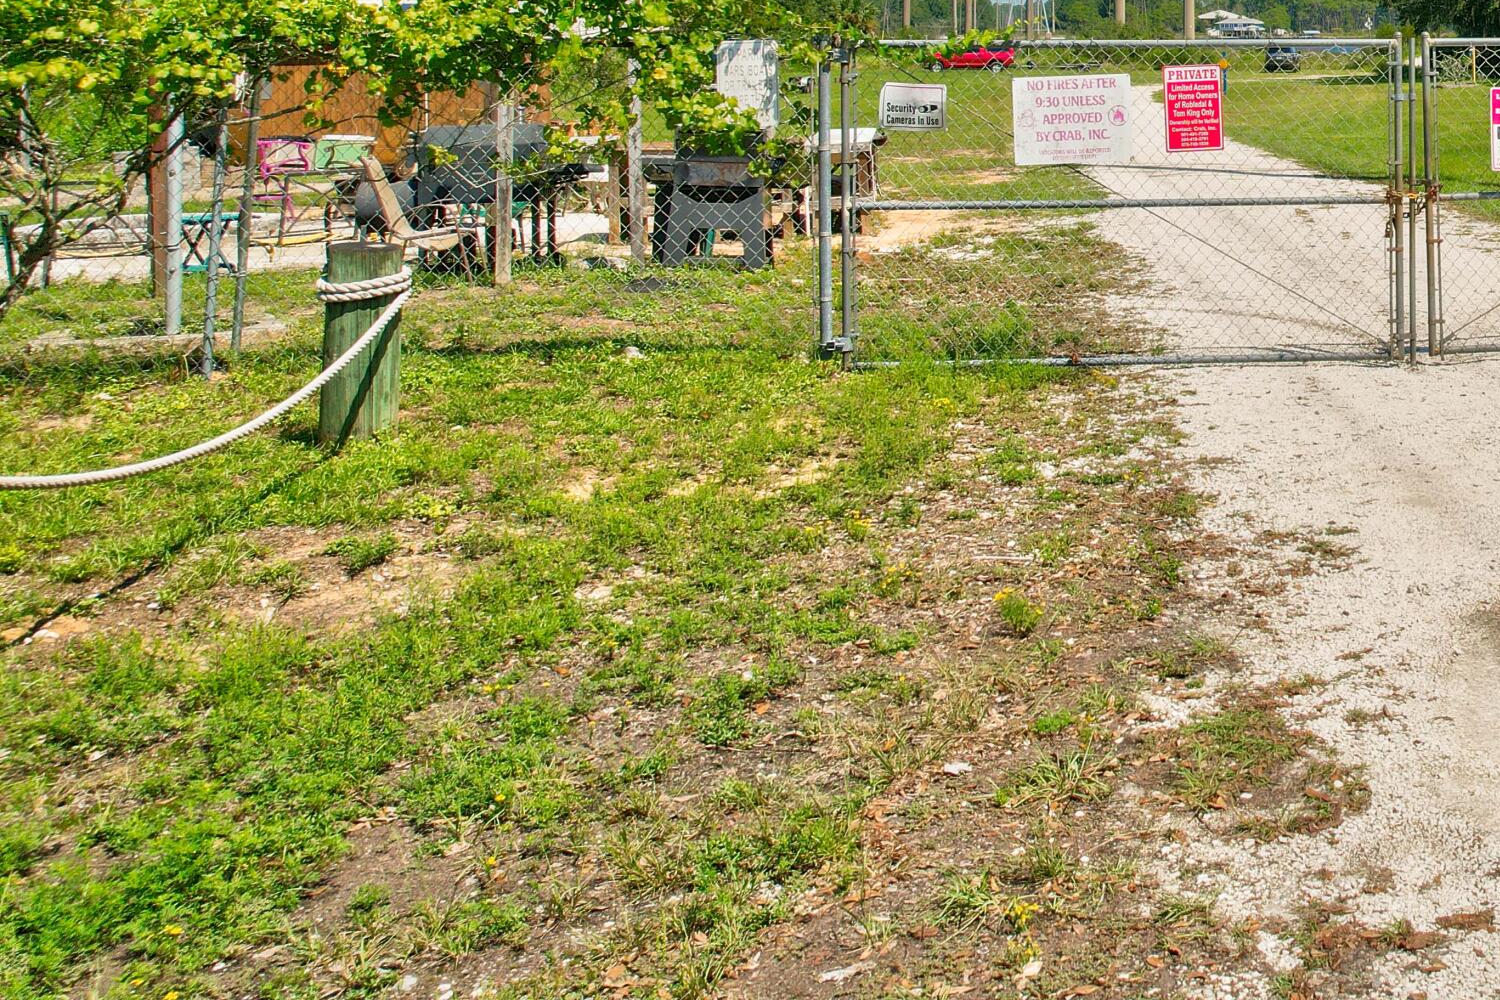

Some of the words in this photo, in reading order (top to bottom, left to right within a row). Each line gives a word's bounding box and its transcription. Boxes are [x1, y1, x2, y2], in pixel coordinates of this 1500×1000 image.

[1168, 69, 1217, 80] PRIVATE
[1027, 80, 1044, 91] NO
[1047, 79, 1079, 90] FIRES
[1081, 77, 1117, 89] AFTER
[1035, 96, 1060, 108] 9:30
[1062, 95, 1106, 107] UNLESS
[886, 102, 916, 114] Security
[1186, 109, 1200, 118] King
[1201, 108, 1214, 117] Only
[886, 115, 916, 125] Cameras
[918, 116, 925, 125] In
[926, 116, 940, 126] Use
[1042, 112, 1103, 125] APPROVED
[1036, 132, 1050, 142] BY
[1052, 130, 1085, 142] CRAB,
